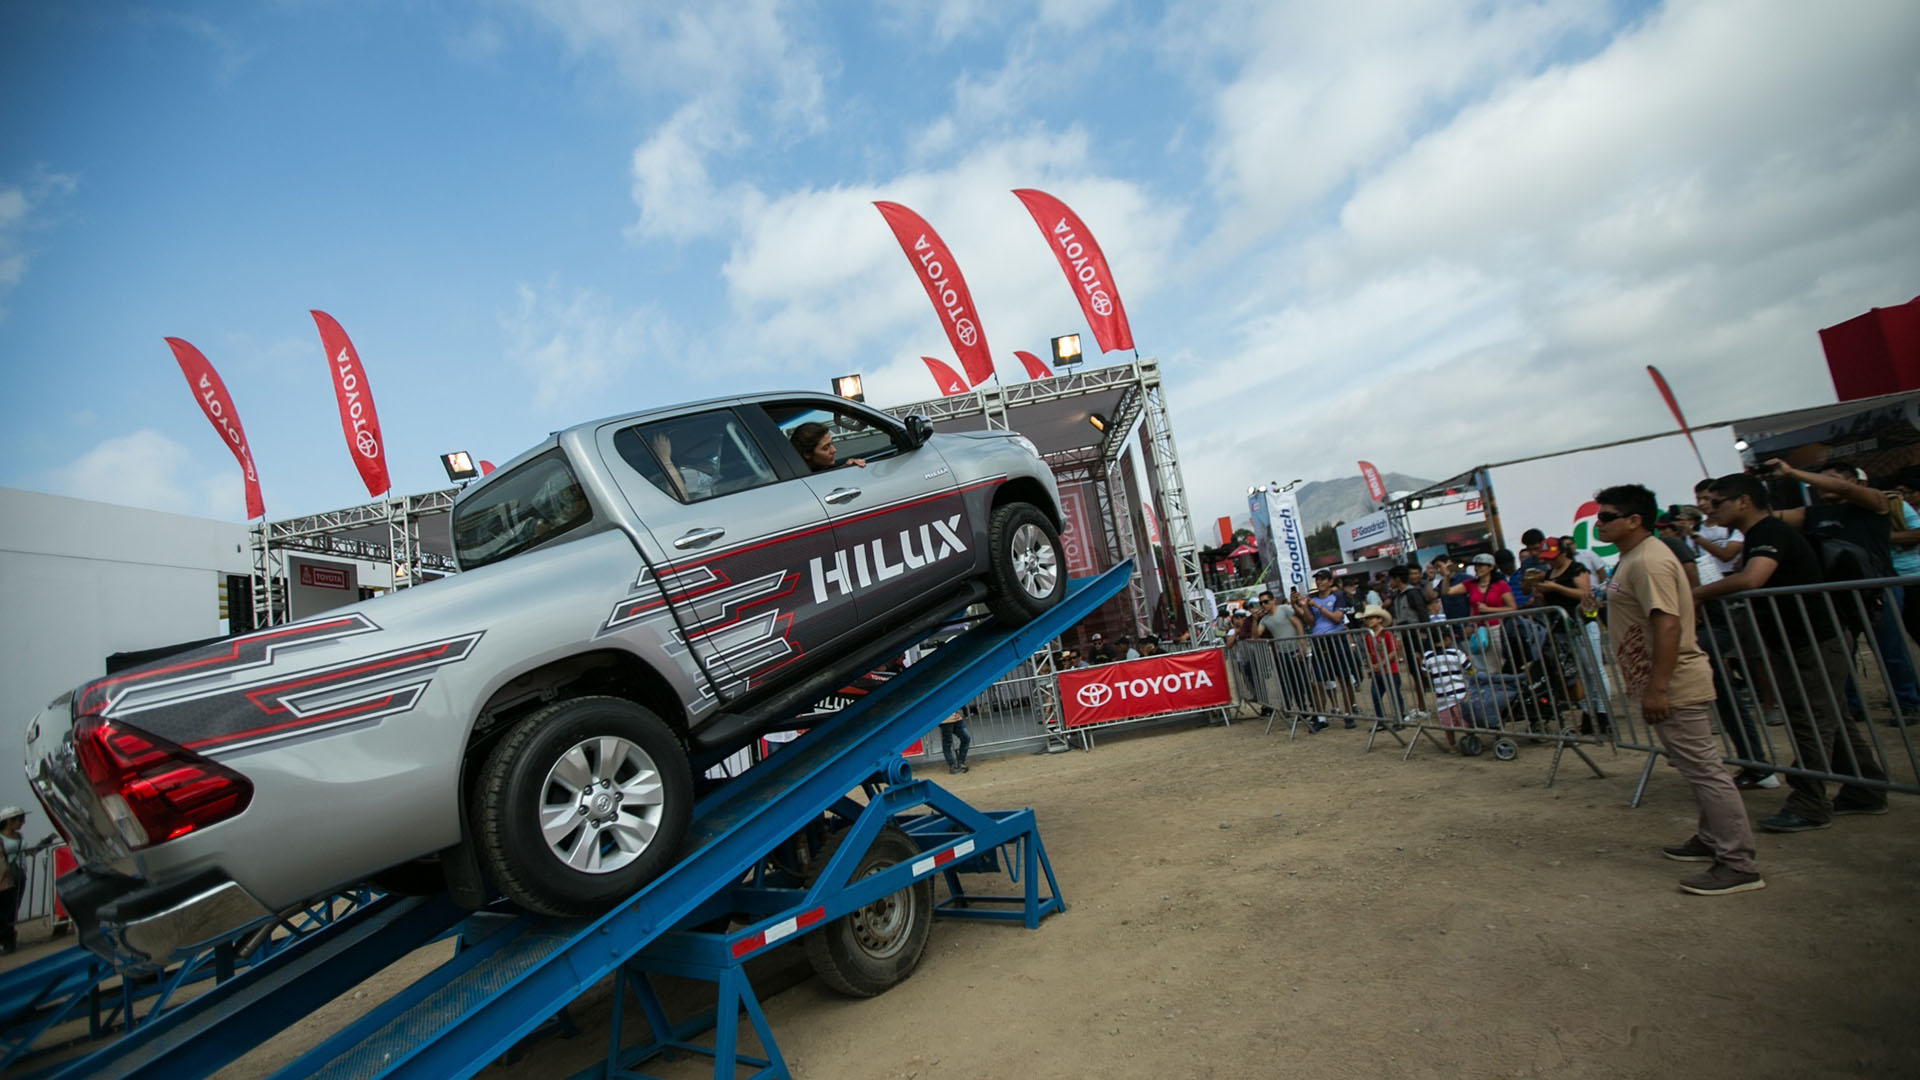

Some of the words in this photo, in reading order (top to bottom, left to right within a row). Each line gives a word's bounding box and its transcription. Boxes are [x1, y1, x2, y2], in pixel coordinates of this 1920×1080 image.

[914, 233, 964, 323] TOYOTA
[1054, 217, 1101, 295] TOYOTA
[199, 372, 250, 460] TOYOTA
[337, 346, 366, 433] TOYOTA
[810, 513, 968, 604] HILUX
[1060, 500, 1080, 569] TOYOTA
[316, 573, 342, 582] TOYOTA
[1114, 669, 1213, 700] TOYOTA
